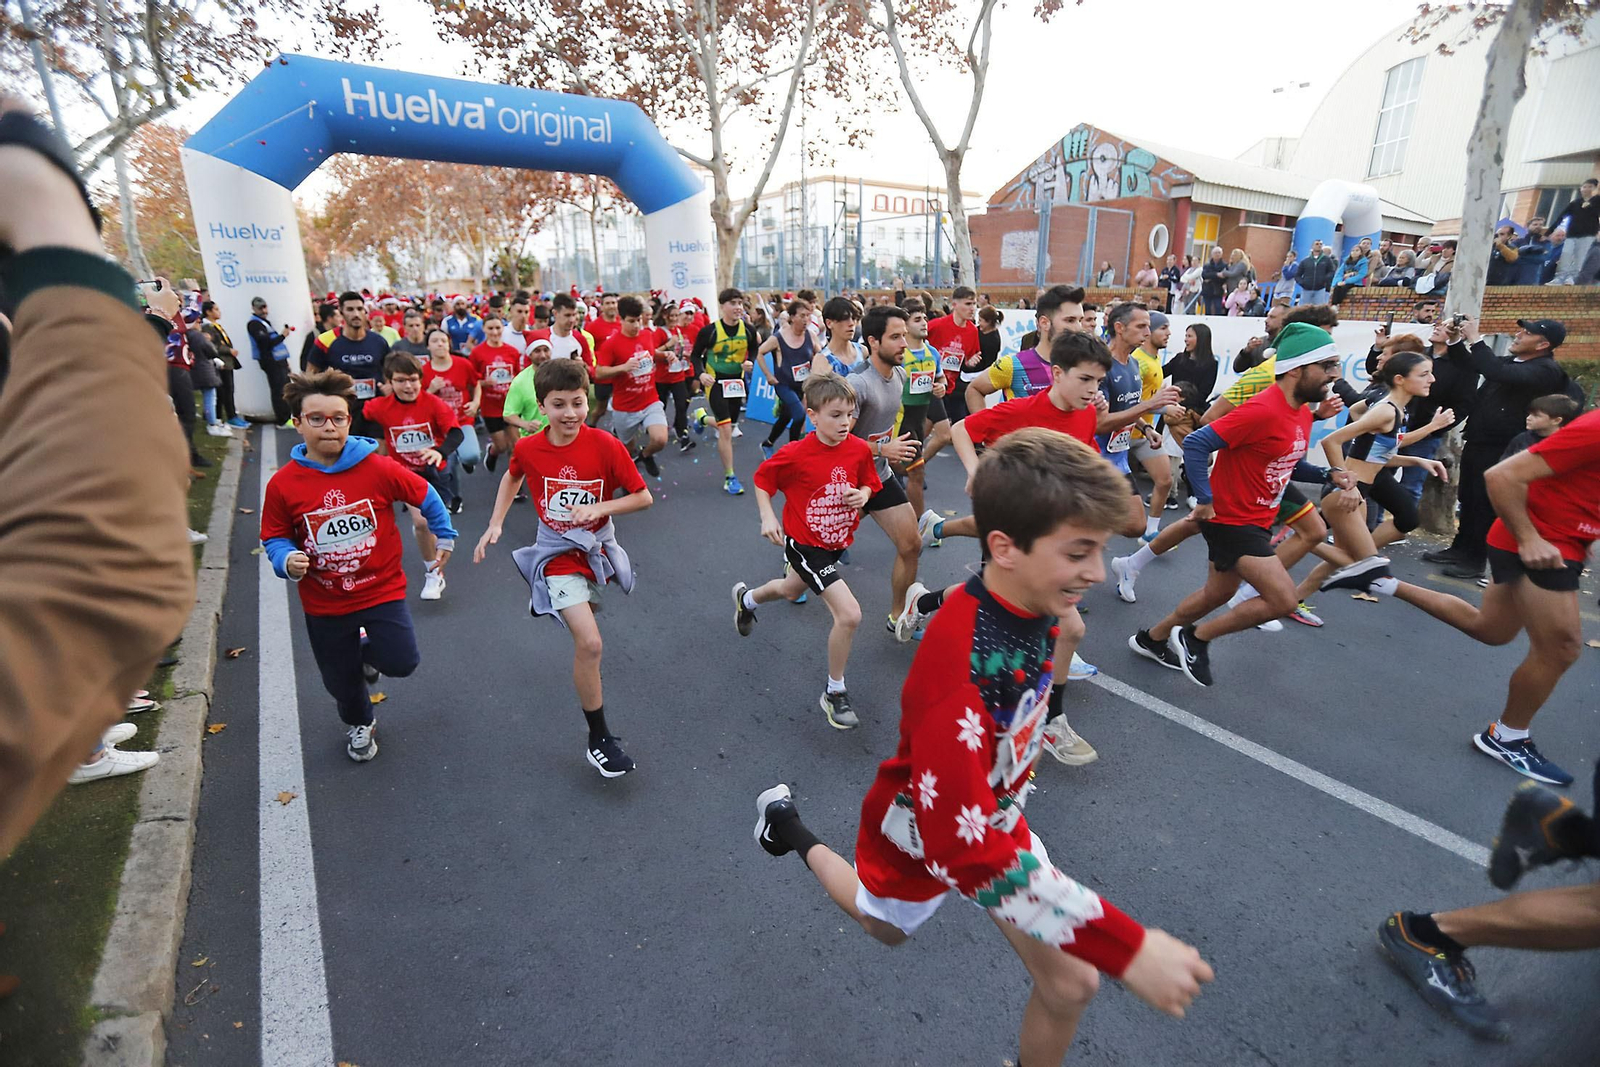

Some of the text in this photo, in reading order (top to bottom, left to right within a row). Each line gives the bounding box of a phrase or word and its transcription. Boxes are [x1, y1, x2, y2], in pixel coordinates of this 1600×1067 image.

[341, 78, 612, 146] Huelva original
[209, 222, 281, 241] Huelva
[245, 276, 288, 284] HUELVA
[559, 491, 590, 507] 574
[326, 516, 361, 537] 486
